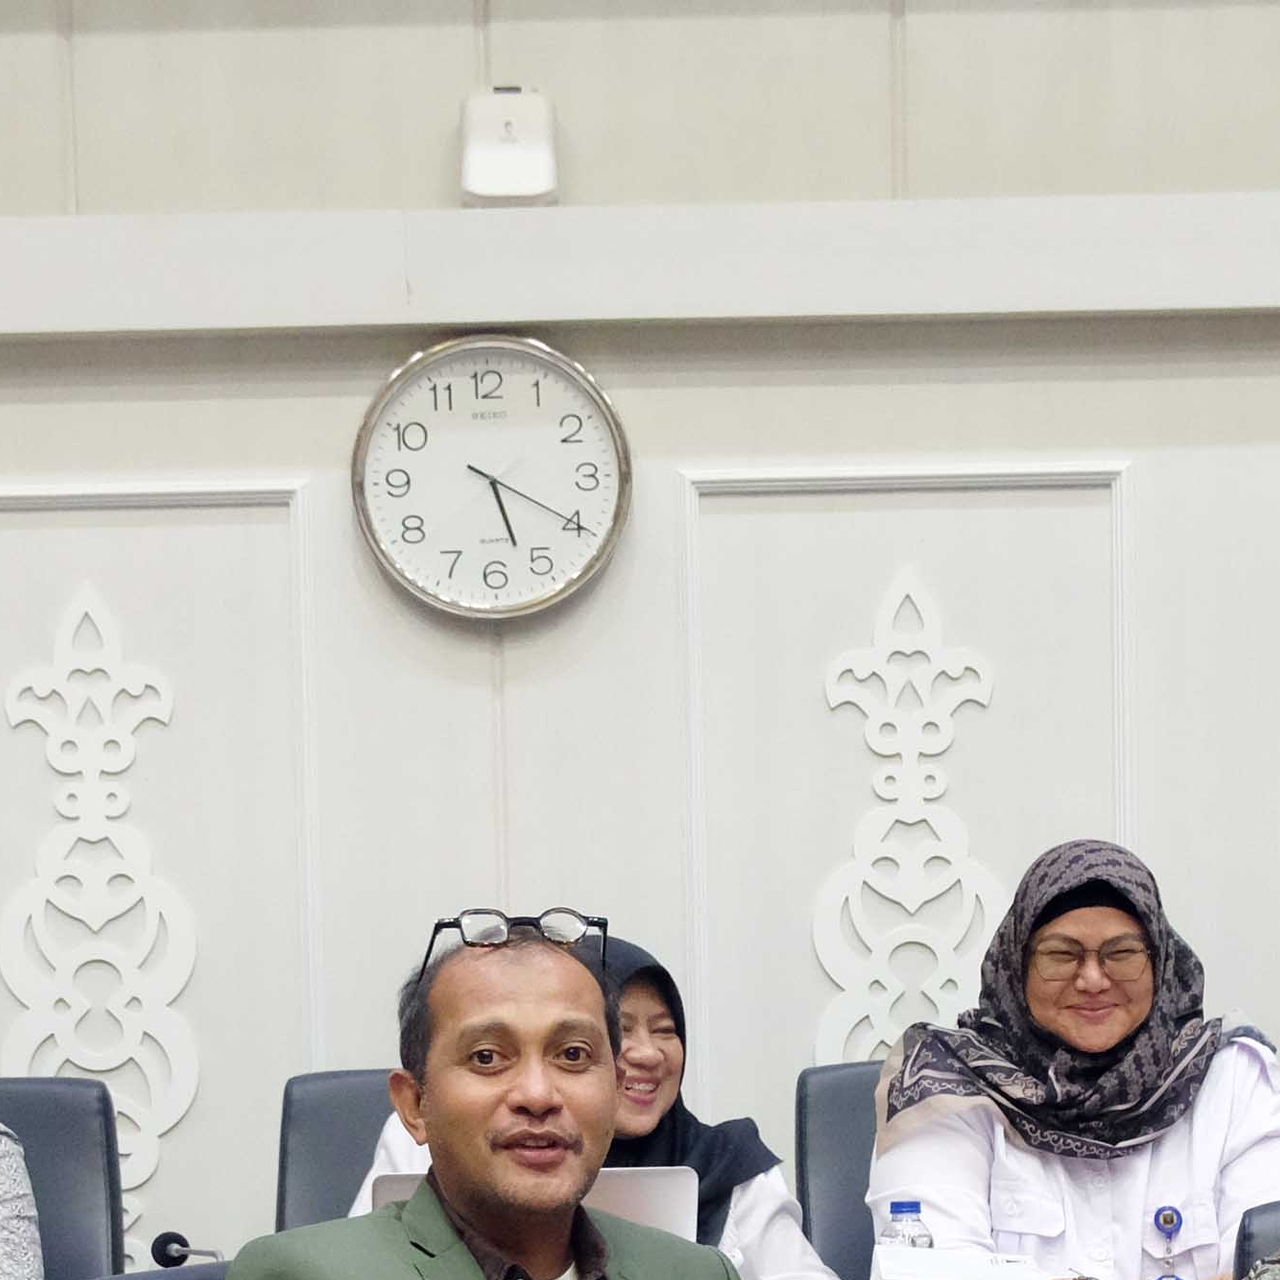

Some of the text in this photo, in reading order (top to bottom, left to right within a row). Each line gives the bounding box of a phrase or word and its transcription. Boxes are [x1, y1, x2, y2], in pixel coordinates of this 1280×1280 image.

[428, 383, 453, 411] 11
[470, 369, 504, 400] 12
[531, 379, 541, 408] 1
[393, 421, 428, 452] 10
[559, 413, 584, 443] 2
[385, 468, 411, 498] 9
[574, 462, 600, 491] 3
[400, 514, 426, 544] 8
[561, 509, 585, 538] 4
[439, 549, 463, 579] 7
[482, 560, 508, 590] 6
[529, 546, 554, 576] 5
